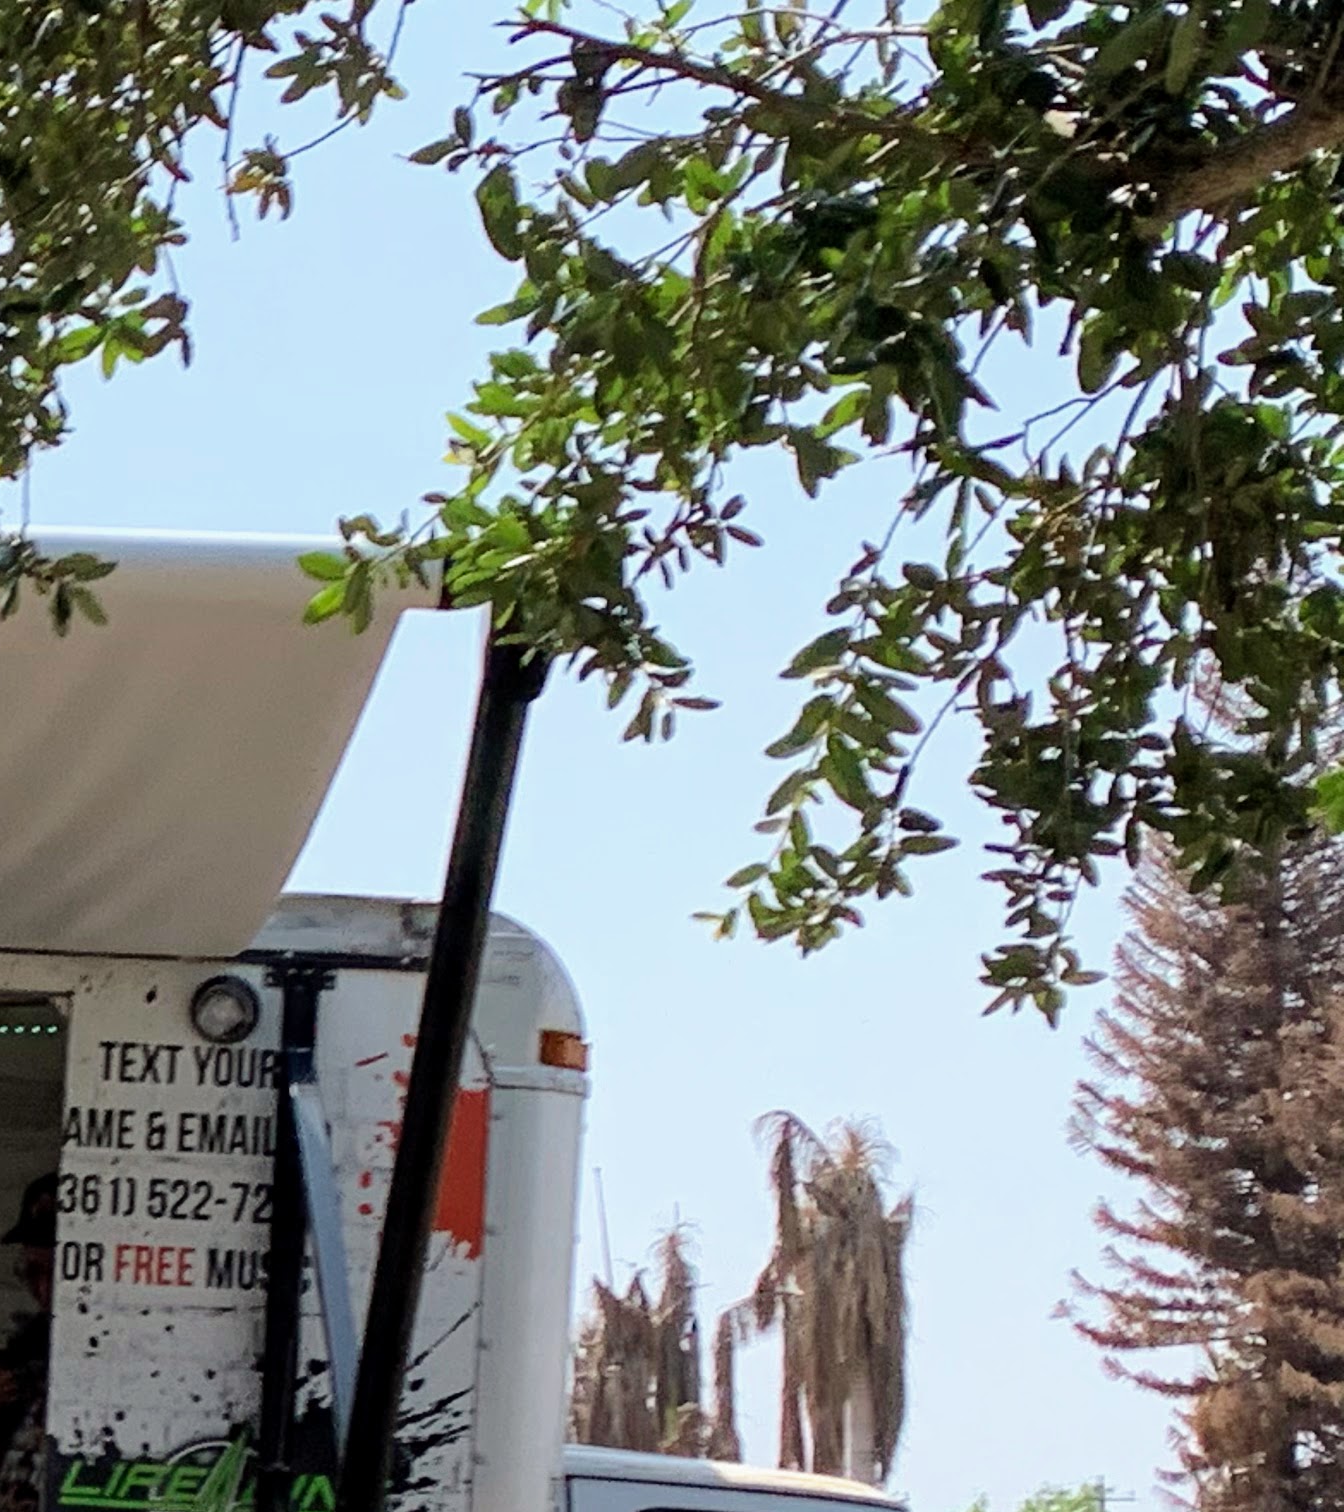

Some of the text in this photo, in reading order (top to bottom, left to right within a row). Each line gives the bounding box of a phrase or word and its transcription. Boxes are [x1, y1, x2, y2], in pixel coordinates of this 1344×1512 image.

[99, 1041, 279, 1090] TEXT YOUR
[64, 1108, 276, 1156] AME & EMAIL
[58, 1174, 272, 1224] 361) 522-72
[57, 1241, 103, 1282] OR
[114, 1244, 195, 1287] FREE
